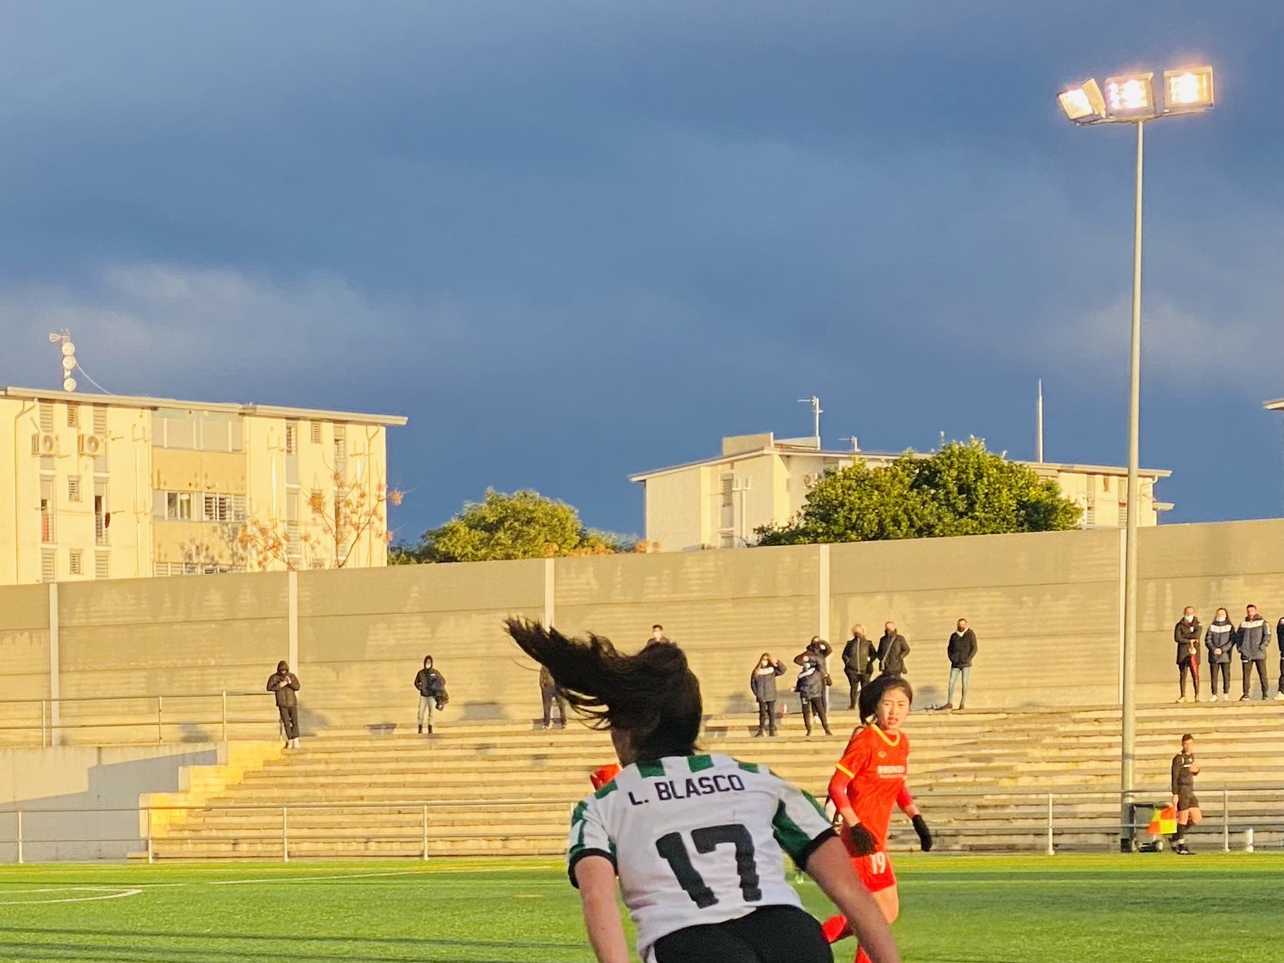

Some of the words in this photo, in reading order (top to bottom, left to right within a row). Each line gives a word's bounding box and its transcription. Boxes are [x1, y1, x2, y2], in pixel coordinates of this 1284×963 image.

[627, 791, 649, 806] L.
[654, 774, 746, 801] BLASCO
[655, 823, 762, 909] 17
[870, 851, 886, 875] 19
